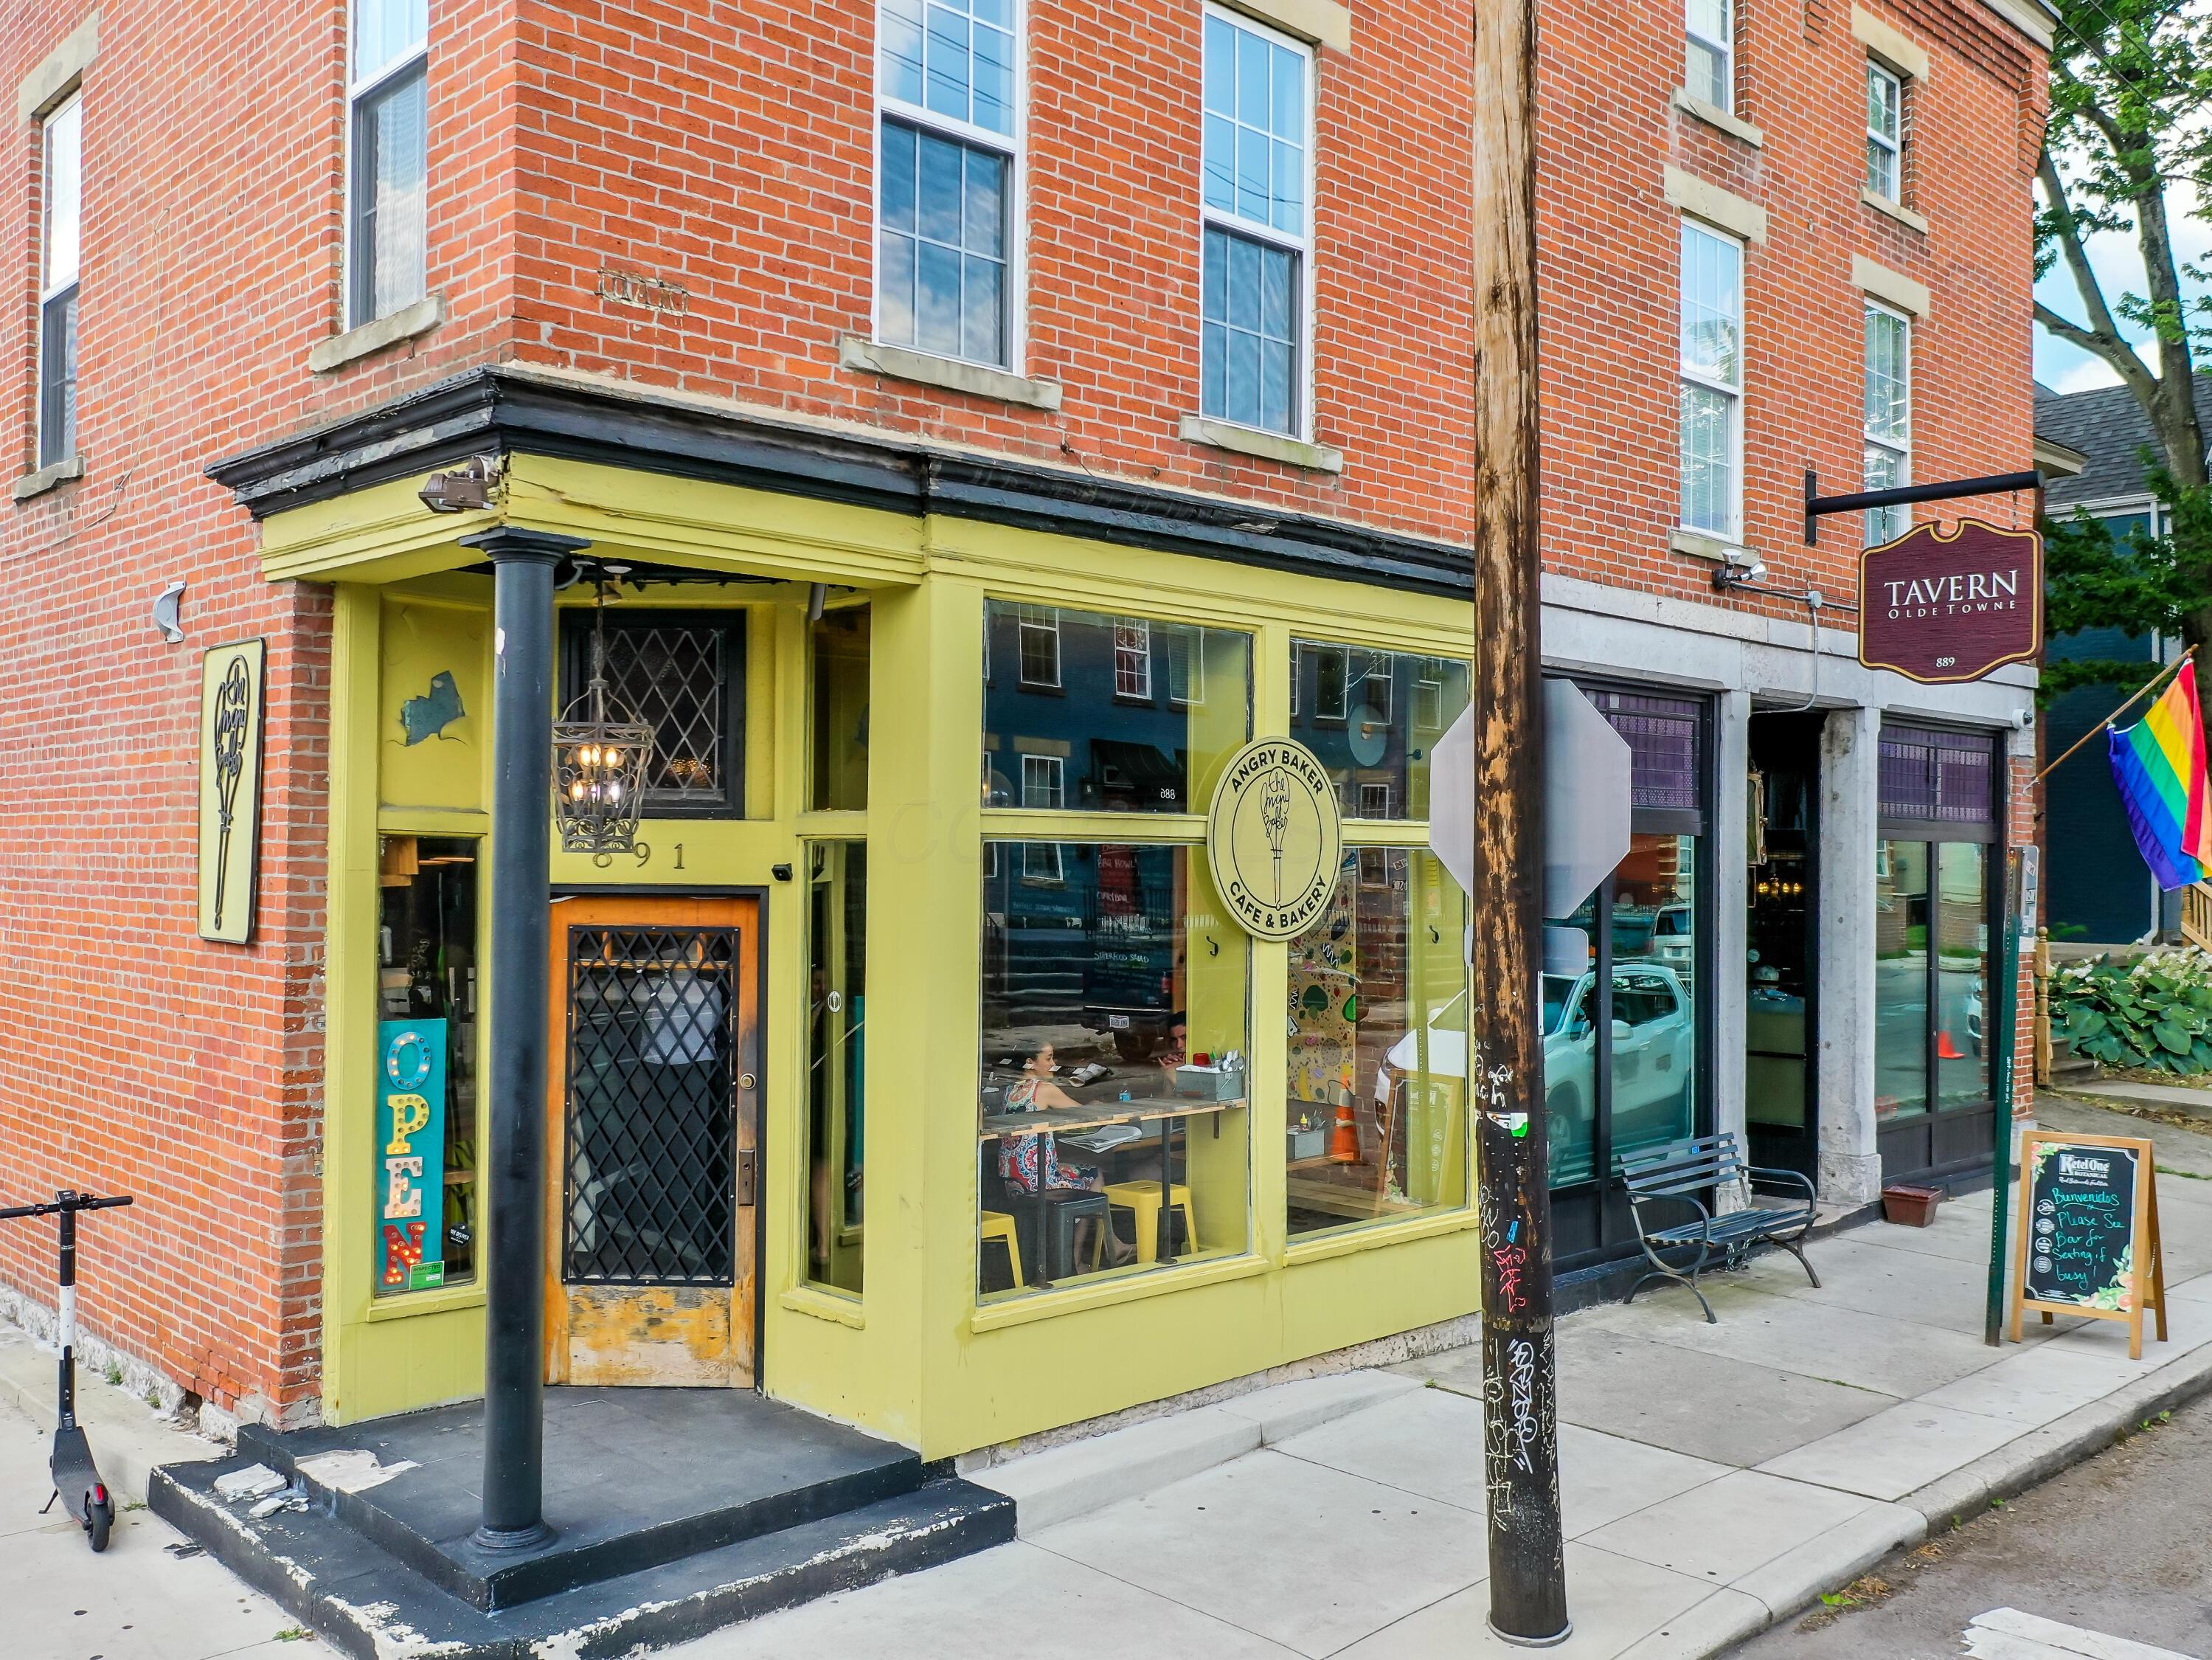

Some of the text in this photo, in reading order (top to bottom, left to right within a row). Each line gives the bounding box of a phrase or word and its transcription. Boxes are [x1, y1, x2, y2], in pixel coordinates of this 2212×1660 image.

[1884, 570, 2018, 606] TAVERN
[1888, 600, 2016, 619] OLDE TOWNE
[1935, 657, 1955, 668] 889
[1231, 749, 1323, 795] ANGRY BAKER
[1230, 874, 1327, 929] CAFE & BAKERY
[384, 1031, 431, 1284] OPEN
[2059, 1153, 2110, 1175] Ketel One
[2056, 1211, 2098, 1228] Please
[2056, 1231, 2084, 1248] Bar
[2086, 1228, 2106, 1247] for
[2052, 1248, 2093, 1266] Seating
